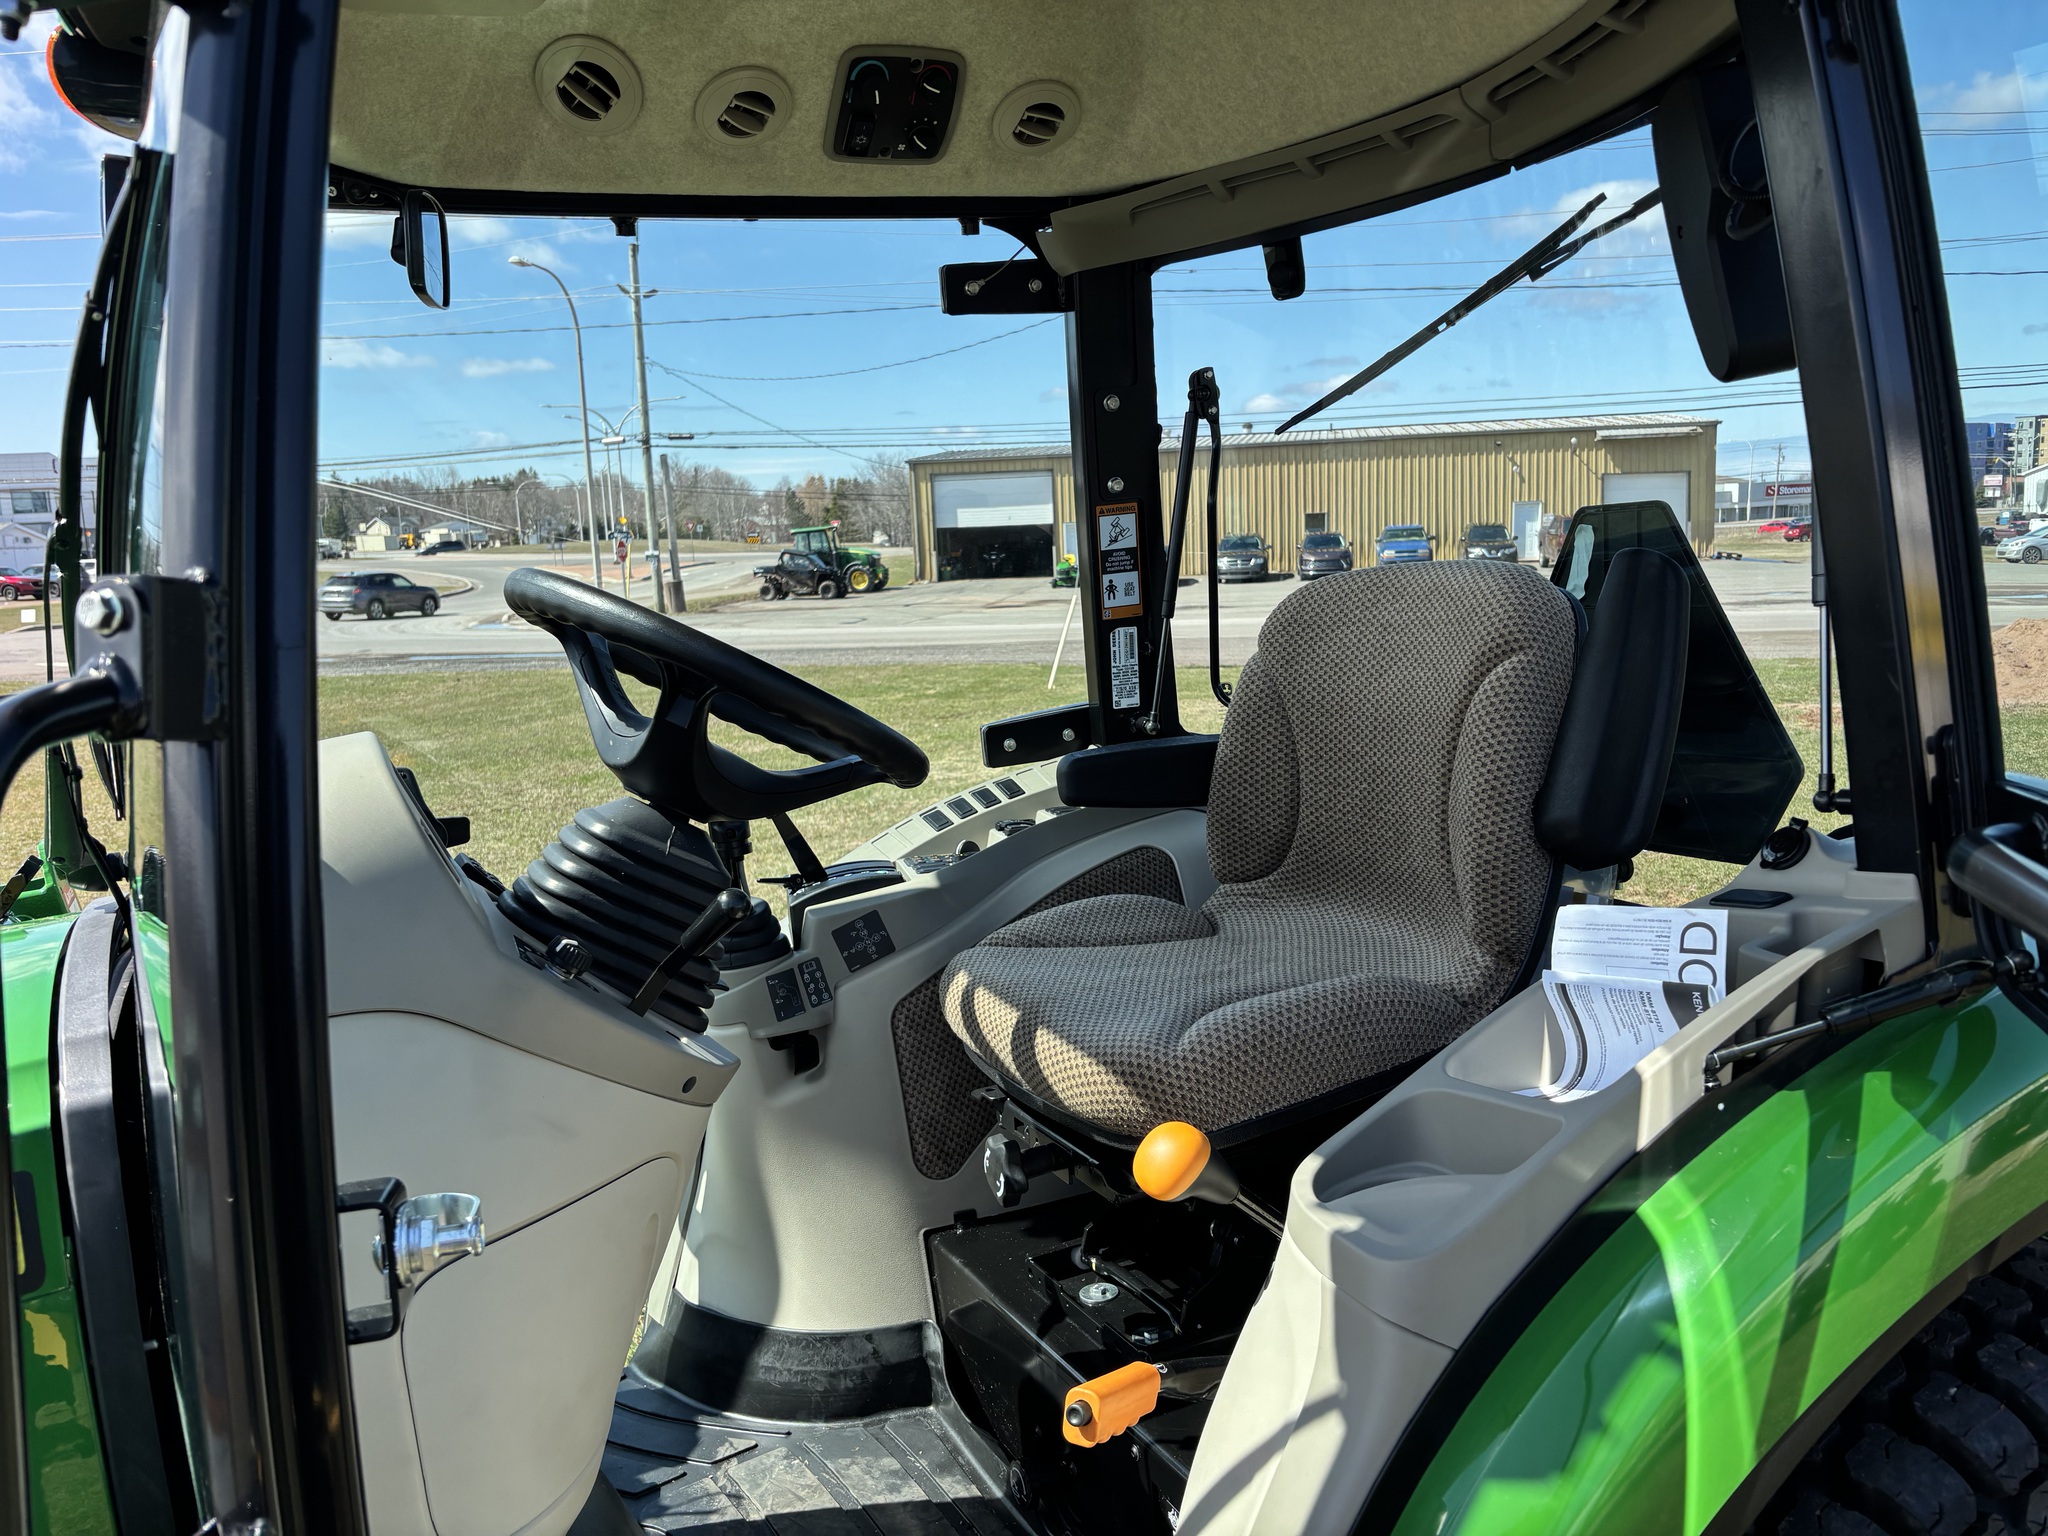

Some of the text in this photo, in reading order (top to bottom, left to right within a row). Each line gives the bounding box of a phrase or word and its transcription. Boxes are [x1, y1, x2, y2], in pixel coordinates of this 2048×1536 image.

[1105, 506, 1136, 514] WARNING
[1638, 991, 1654, 1024] KMM-BT38
[1646, 991, 1664, 1032] KMM-BT332U
